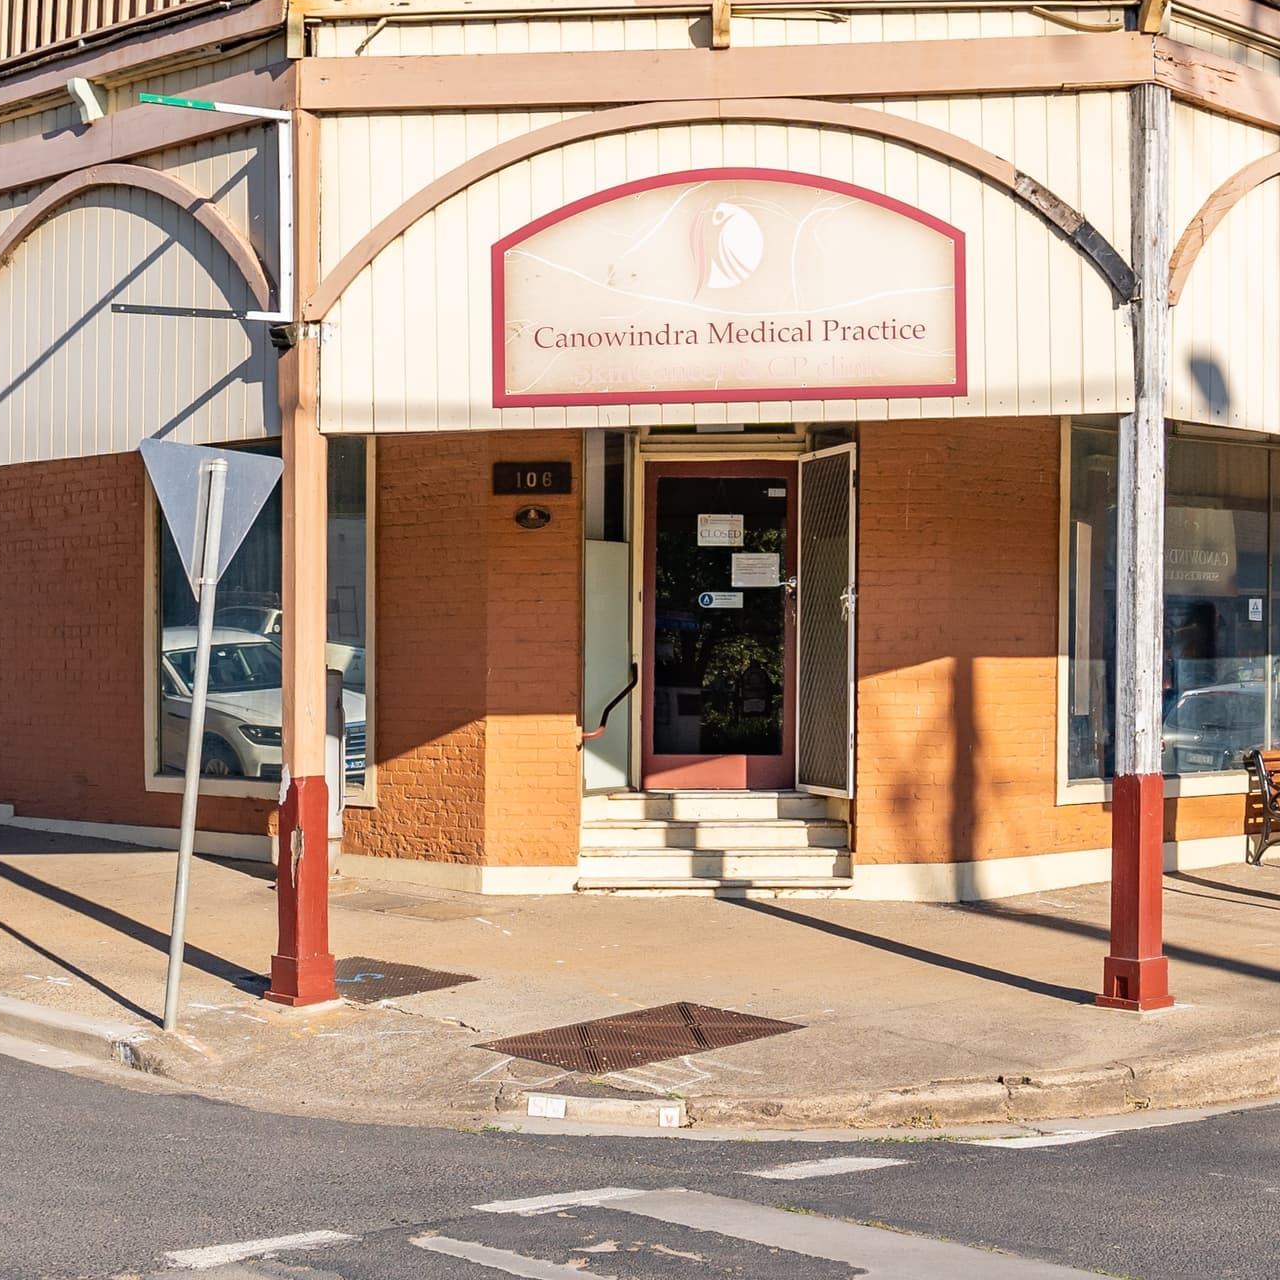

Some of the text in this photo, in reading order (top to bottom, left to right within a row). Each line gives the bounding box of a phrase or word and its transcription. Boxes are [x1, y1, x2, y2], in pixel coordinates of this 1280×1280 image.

[534, 318, 926, 350] Canowindra Medical Practice
[516, 471, 553, 489] 106
[700, 528, 742, 539] CLOSED
